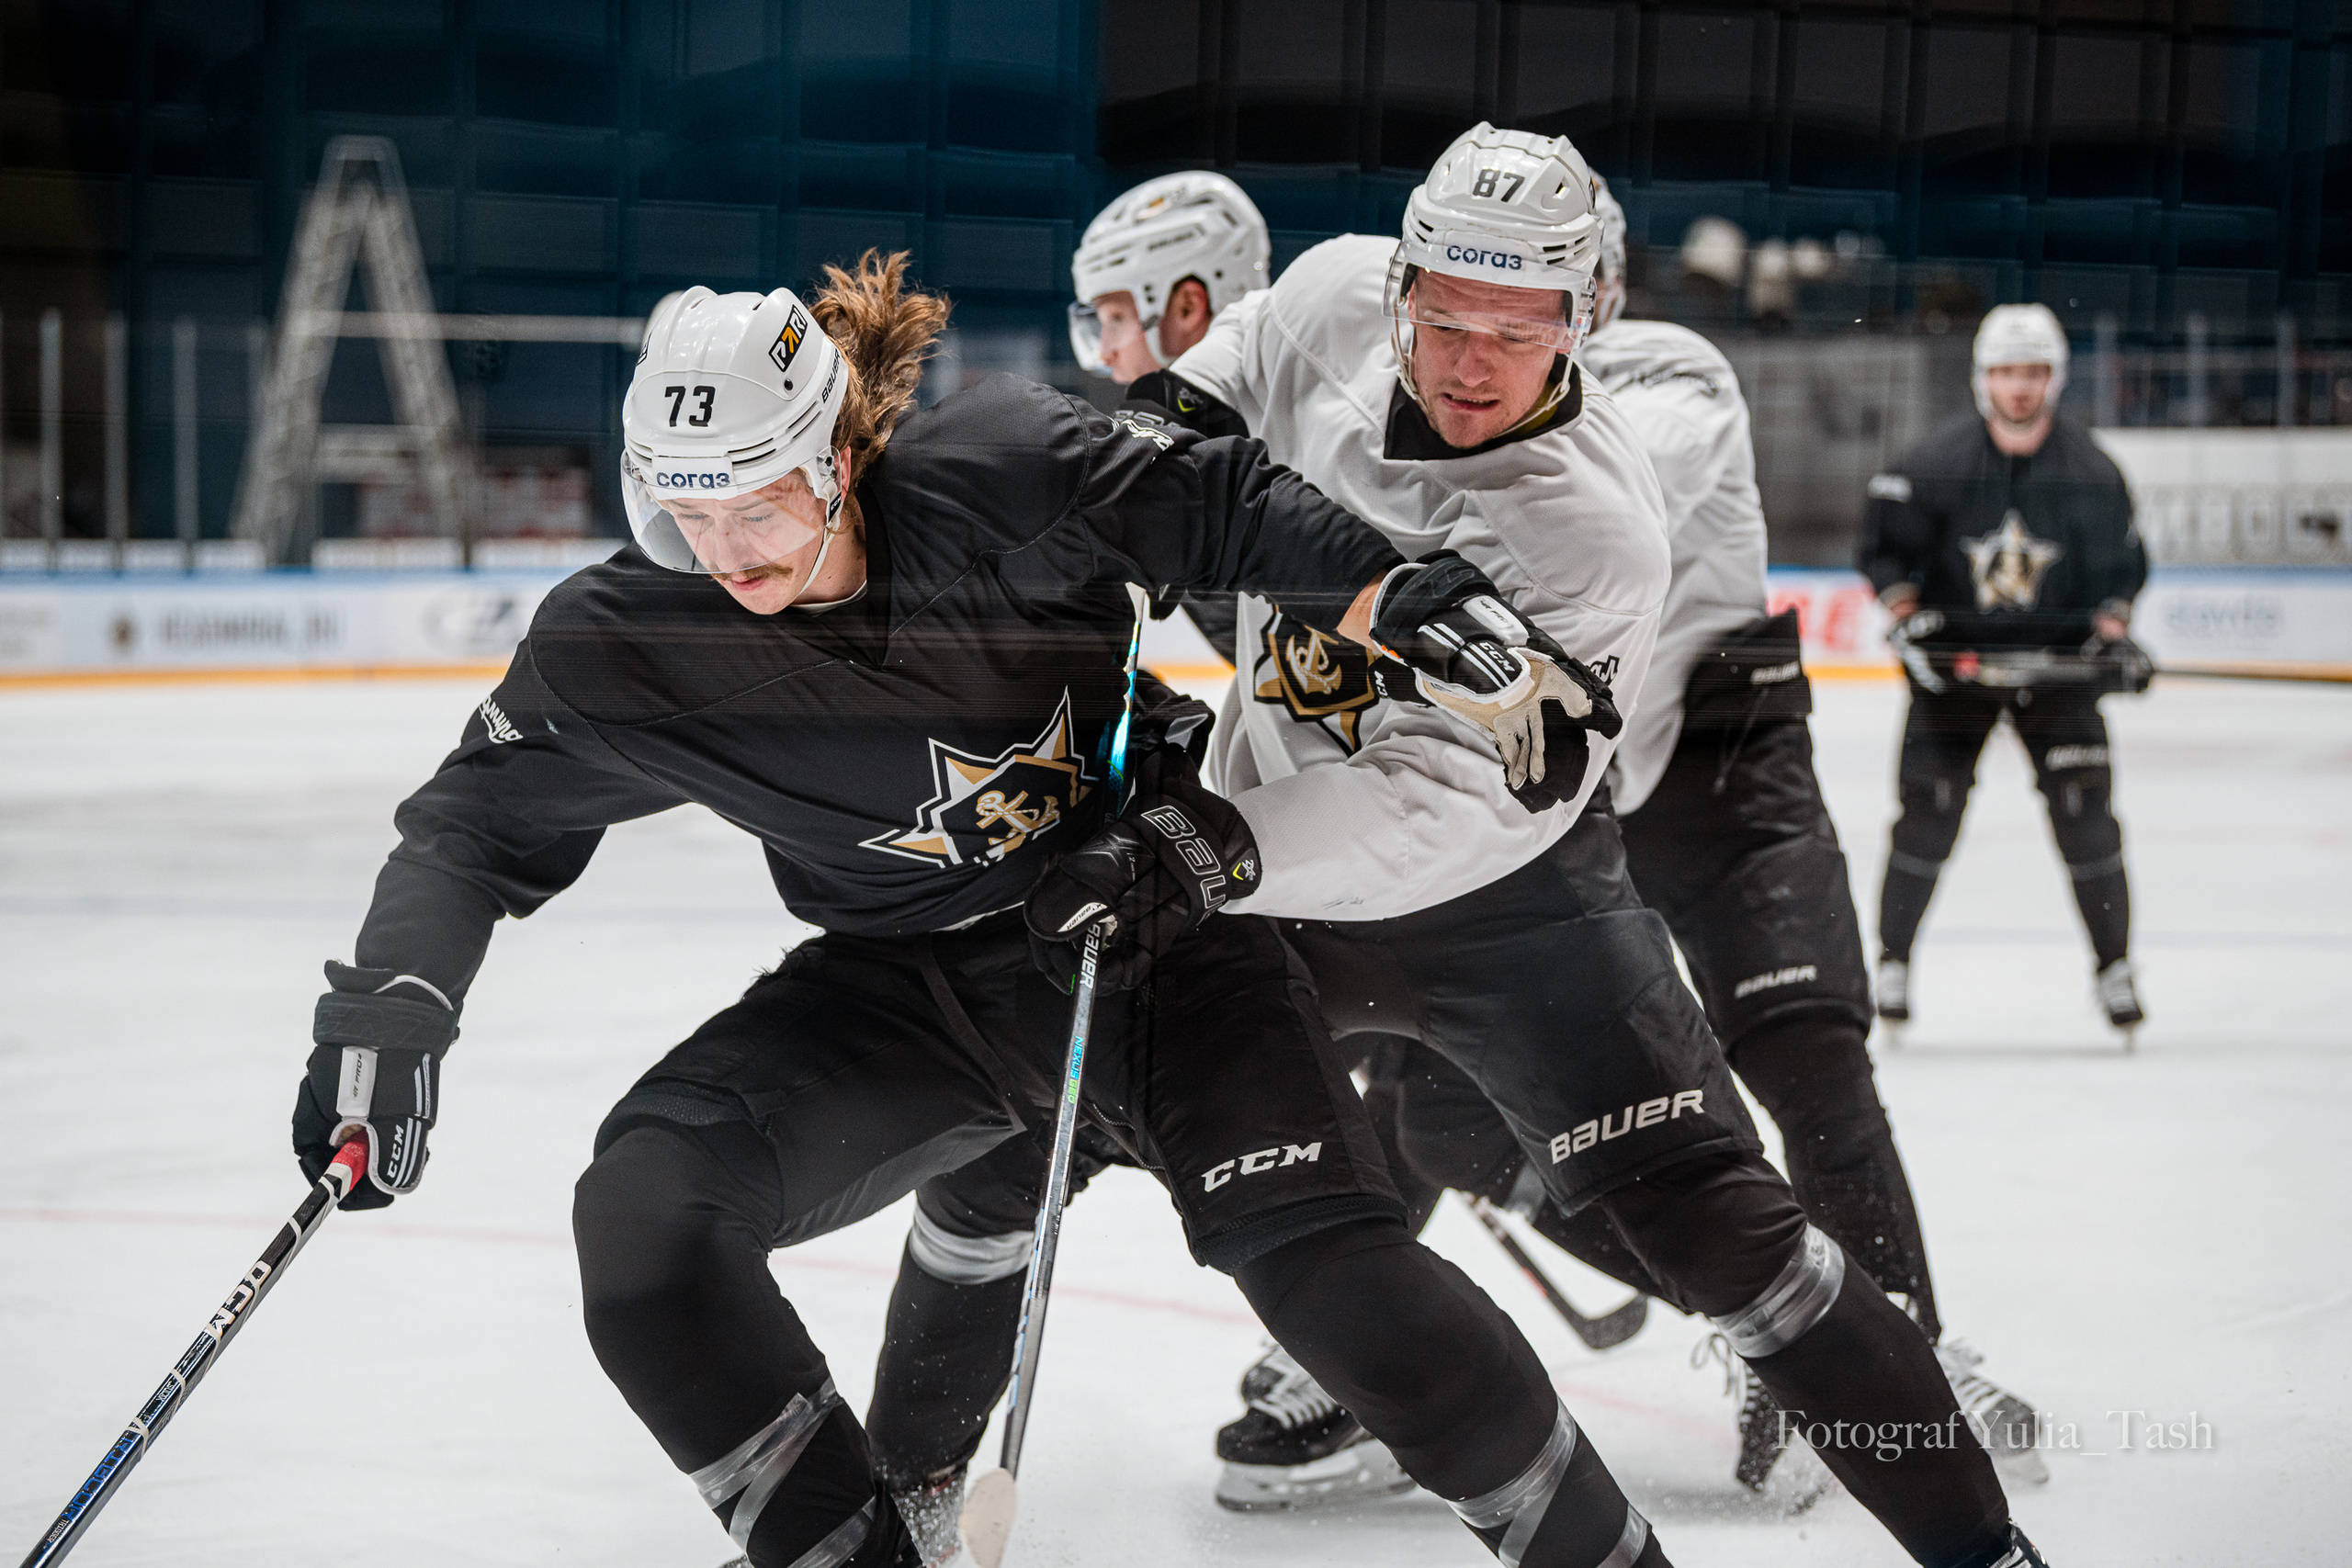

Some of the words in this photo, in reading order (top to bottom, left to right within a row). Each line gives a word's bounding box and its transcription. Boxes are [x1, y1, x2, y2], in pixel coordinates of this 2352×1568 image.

[1472, 168, 1525, 202] 87
[663, 385, 716, 428] 73
[1479, 642, 1516, 671] CCM
[1374, 671, 1388, 697] CM
[1140, 805, 1227, 917] BAU
[1069, 1035, 1084, 1079] NEXUS
[387, 1124, 404, 1179] CCM
[1201, 1142, 1322, 1192] CCM
[62, 1436, 134, 1521] RIBCOR
